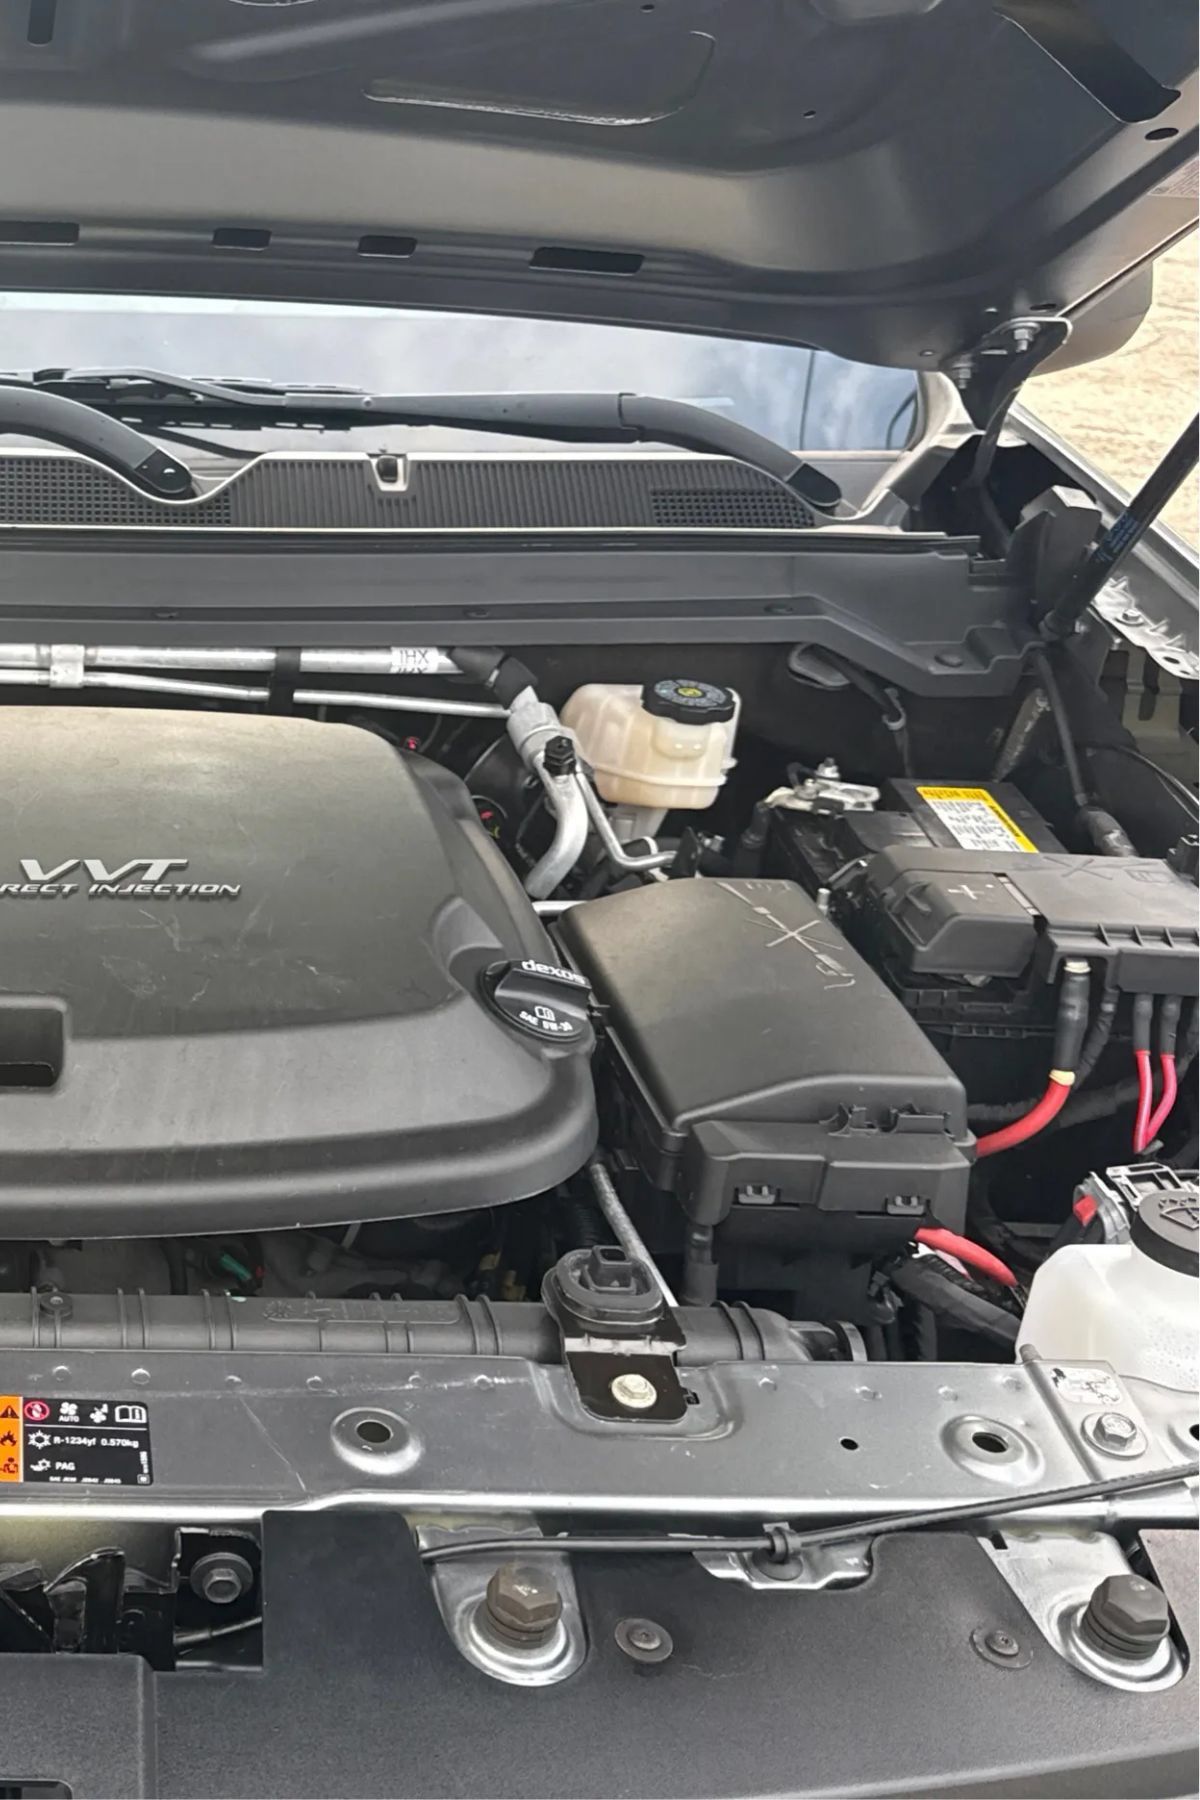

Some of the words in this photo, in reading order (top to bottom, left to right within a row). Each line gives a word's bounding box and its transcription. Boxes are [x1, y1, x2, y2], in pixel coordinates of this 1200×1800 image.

[20, 859, 188, 882] VVT
[89, 883, 240, 897] INJECTION
[521, 959, 586, 985] dexos
[58, 1415, 80, 1423] AUTO
[53, 1435, 97, 1447] R-1234yf
[100, 1437, 140, 1449] 0.570kg
[55, 1461, 76, 1471] PAG
